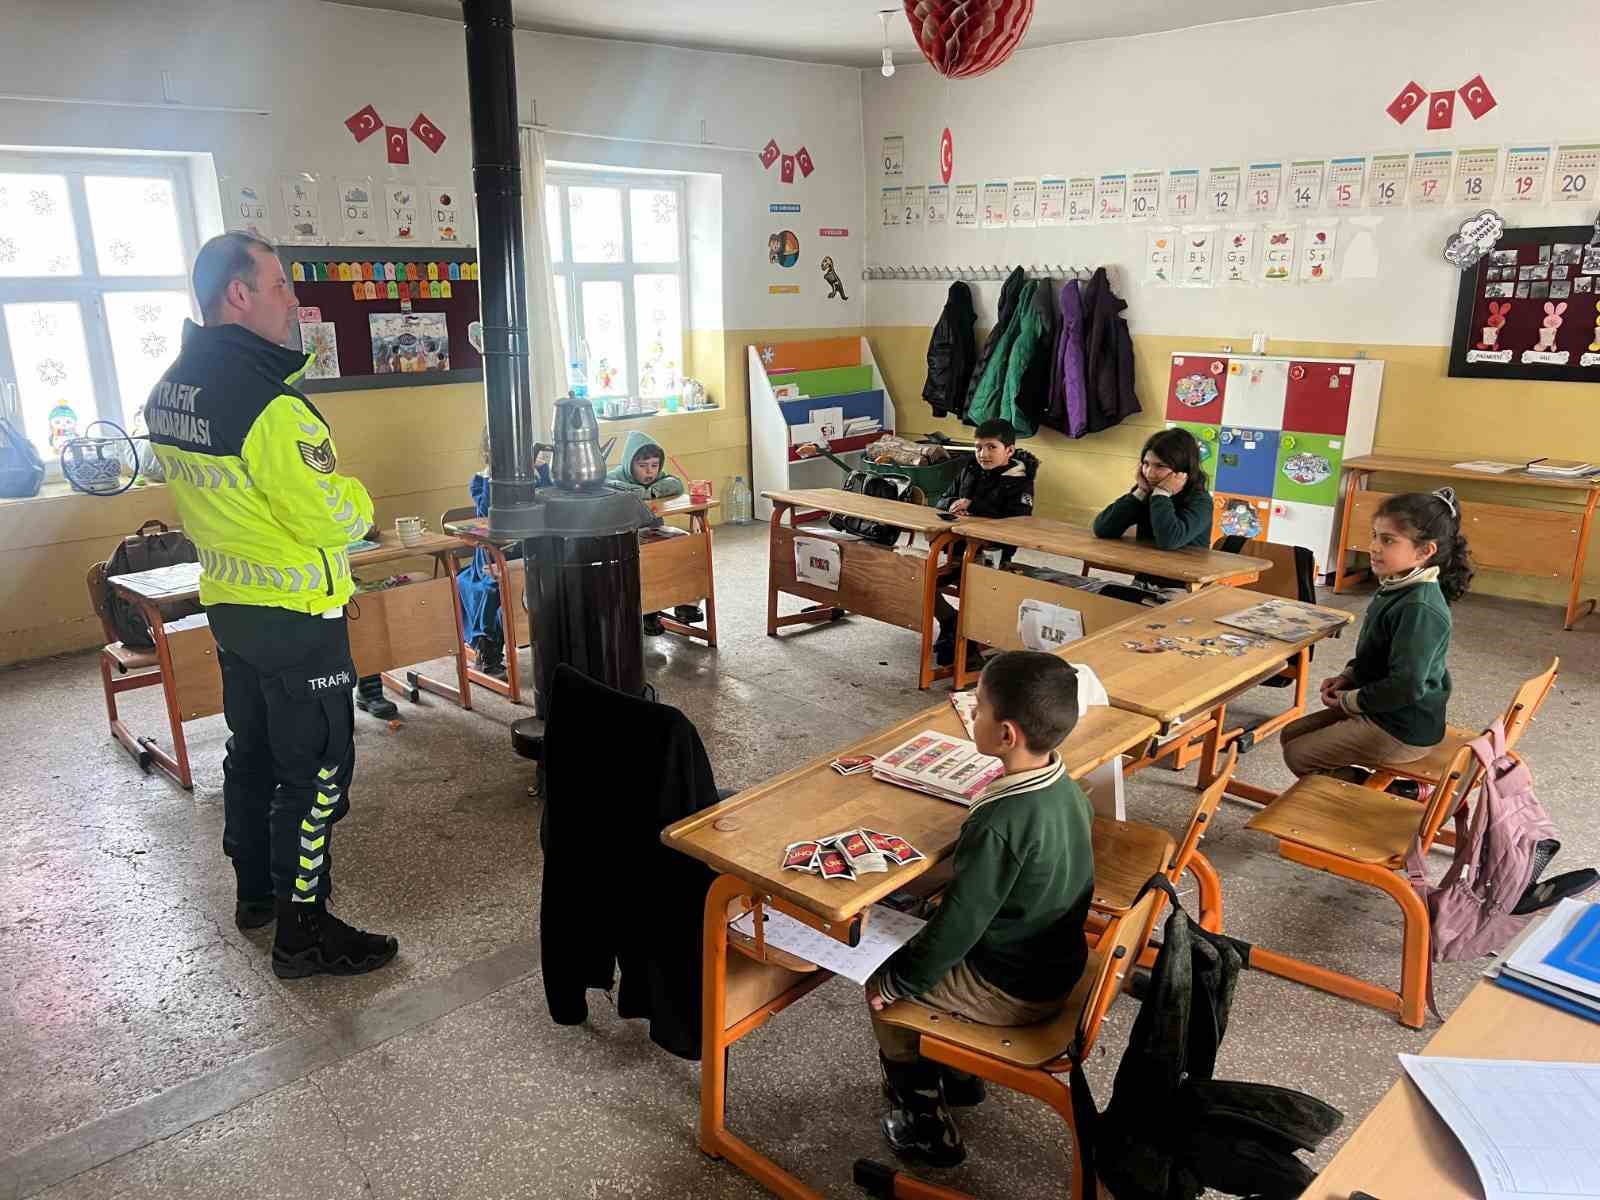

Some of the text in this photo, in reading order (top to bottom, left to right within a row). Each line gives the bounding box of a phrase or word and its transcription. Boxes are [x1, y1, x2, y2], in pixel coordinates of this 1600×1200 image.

[1378, 182, 1395, 198] 16
[1422, 179, 1438, 196] 17
[1465, 177, 1483, 194] 18
[1514, 176, 1533, 194] 19
[1562, 174, 1587, 193] 20
[1214, 191, 1228, 207] 12
[1255, 190, 1269, 205] 13
[1295, 187, 1311, 203] 14
[1336, 184, 1352, 201] 15
[1132, 197, 1146, 211] 10
[1175, 194, 1188, 209] 11
[308, 671, 350, 691] TRAFİK
